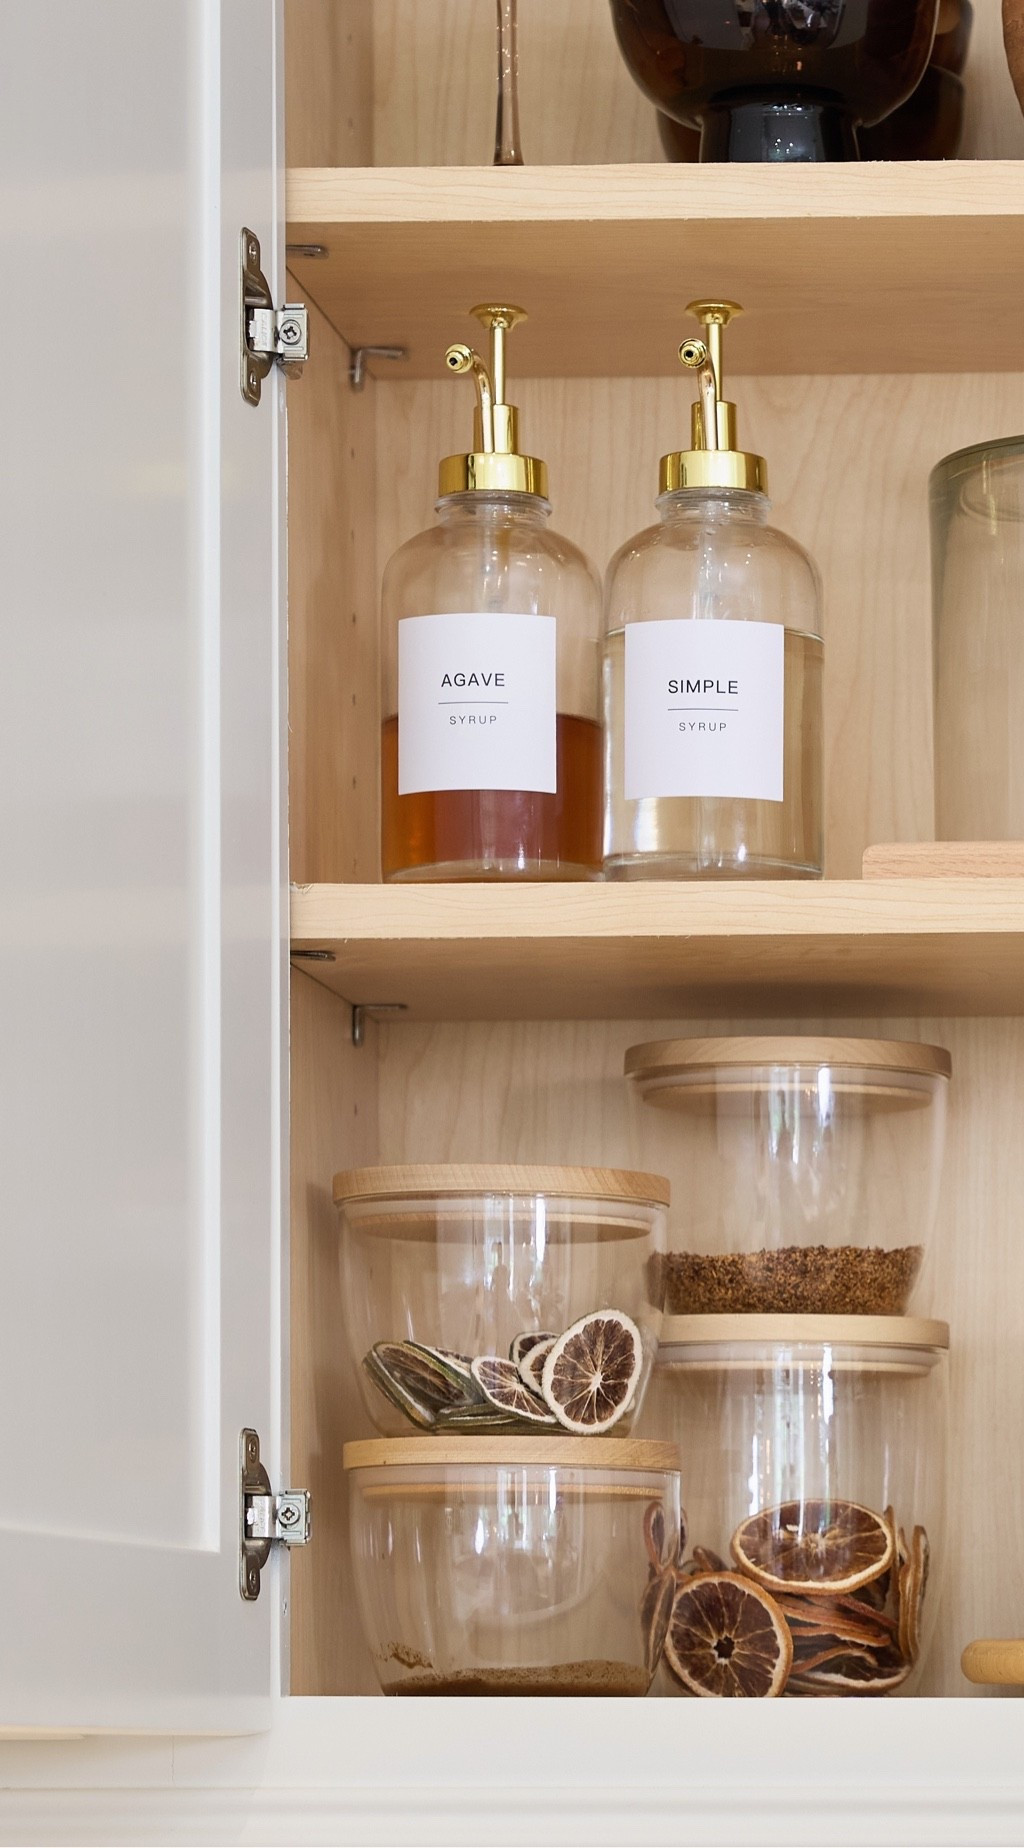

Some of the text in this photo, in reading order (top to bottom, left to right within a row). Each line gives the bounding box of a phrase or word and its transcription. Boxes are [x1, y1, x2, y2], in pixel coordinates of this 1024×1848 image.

[440, 672, 506, 688] AGAVE
[667, 679, 739, 695] SIMPLE
[449, 715, 498, 726] SYRUP
[678, 721, 728, 732] SYRUP
